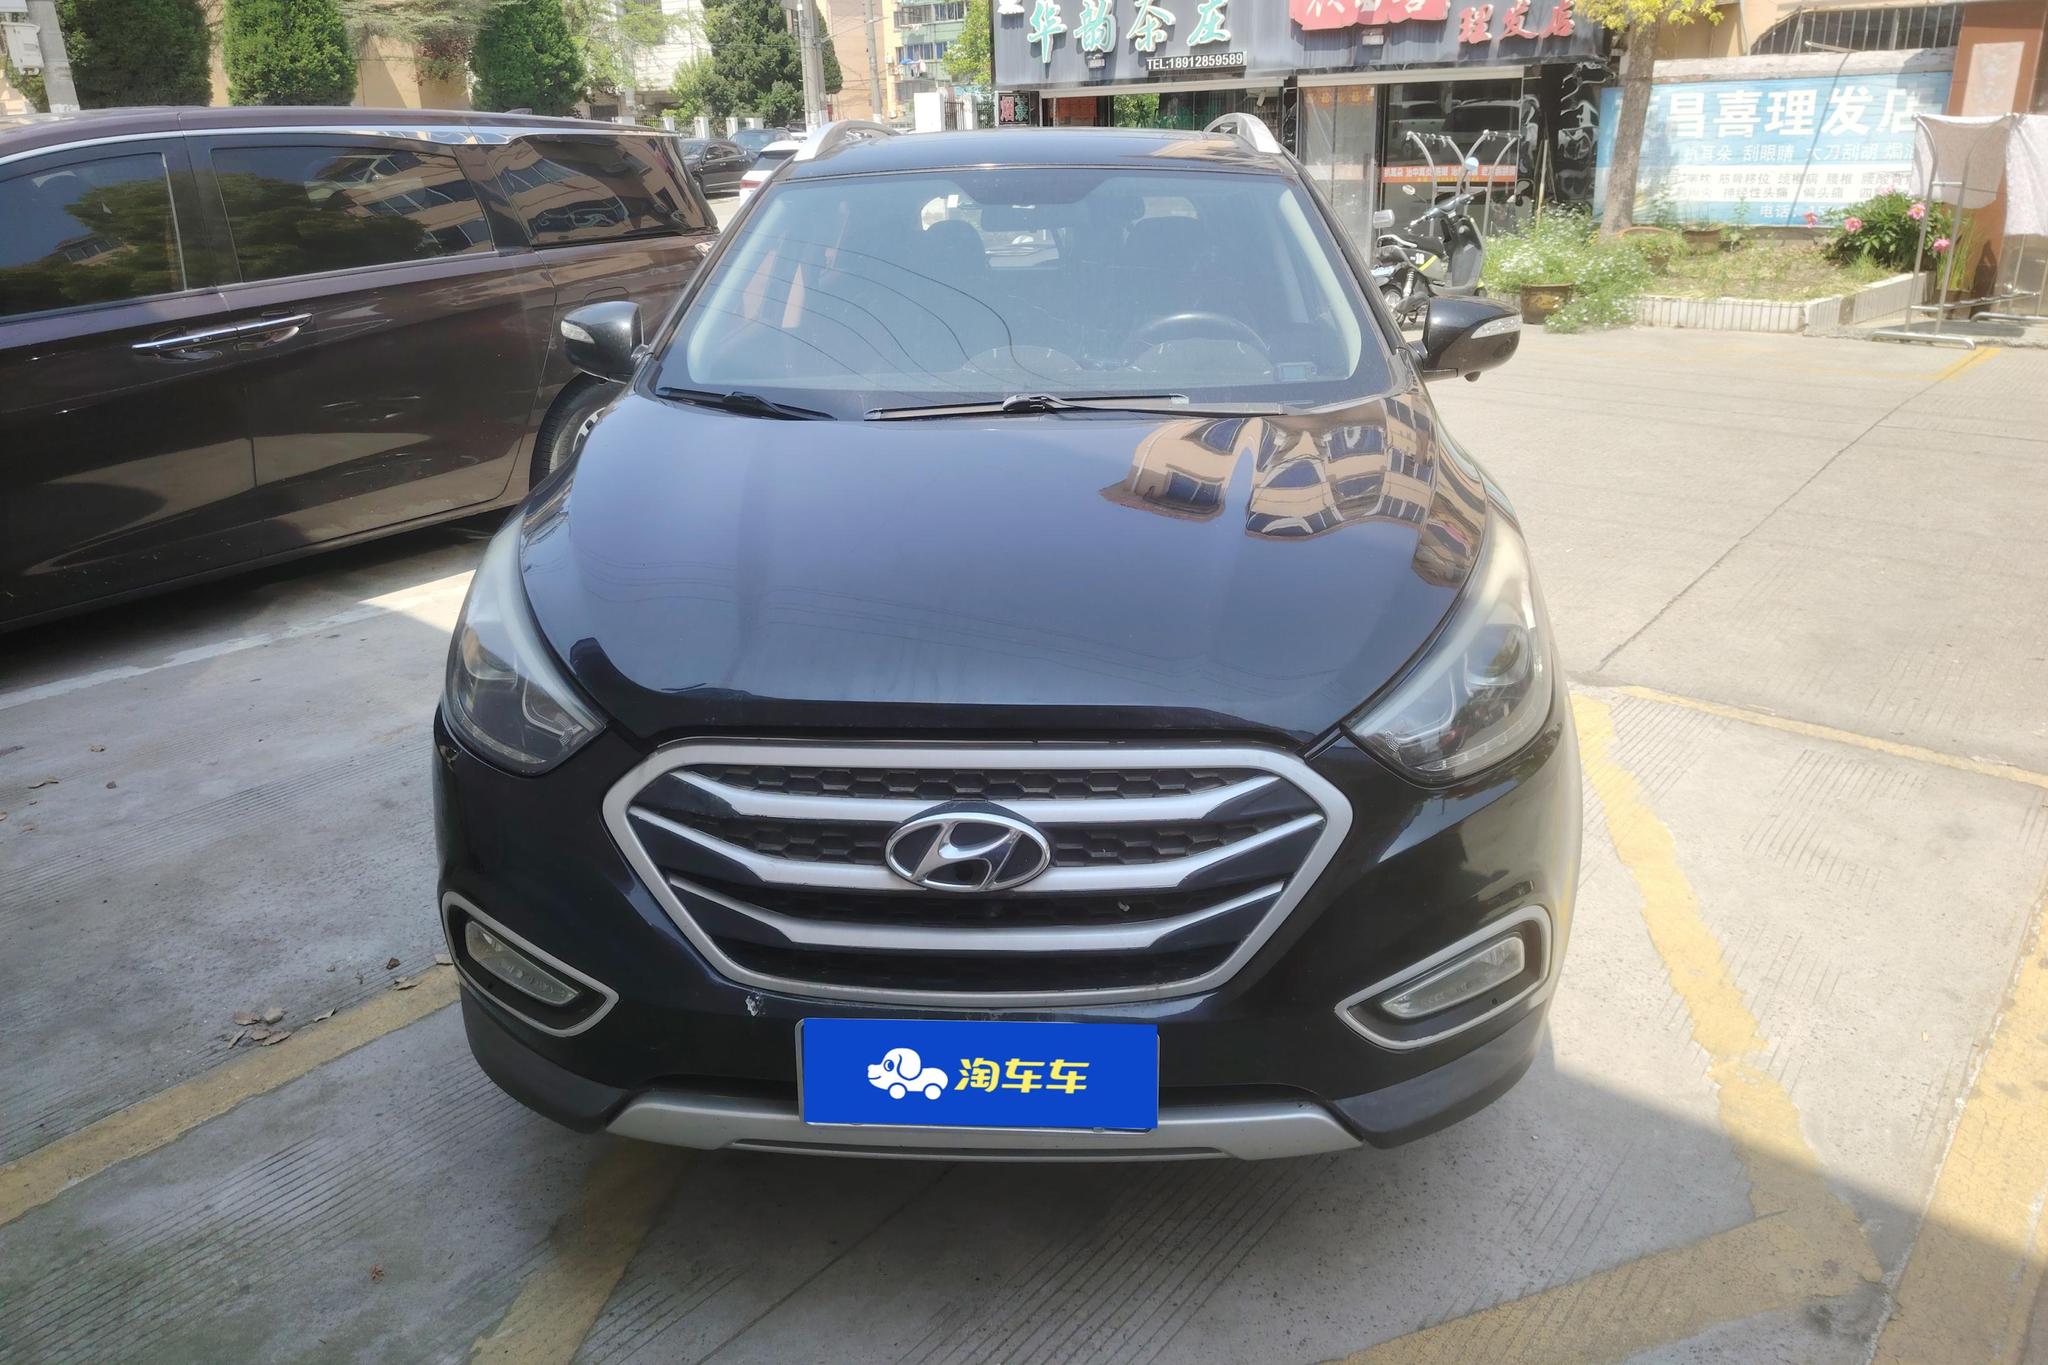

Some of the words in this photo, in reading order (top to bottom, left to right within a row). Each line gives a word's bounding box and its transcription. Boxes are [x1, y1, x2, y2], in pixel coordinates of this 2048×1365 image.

[1147, 52, 1243, 70] TEL:18912859589
[1614, 86, 1918, 138] 昌喜理发店
